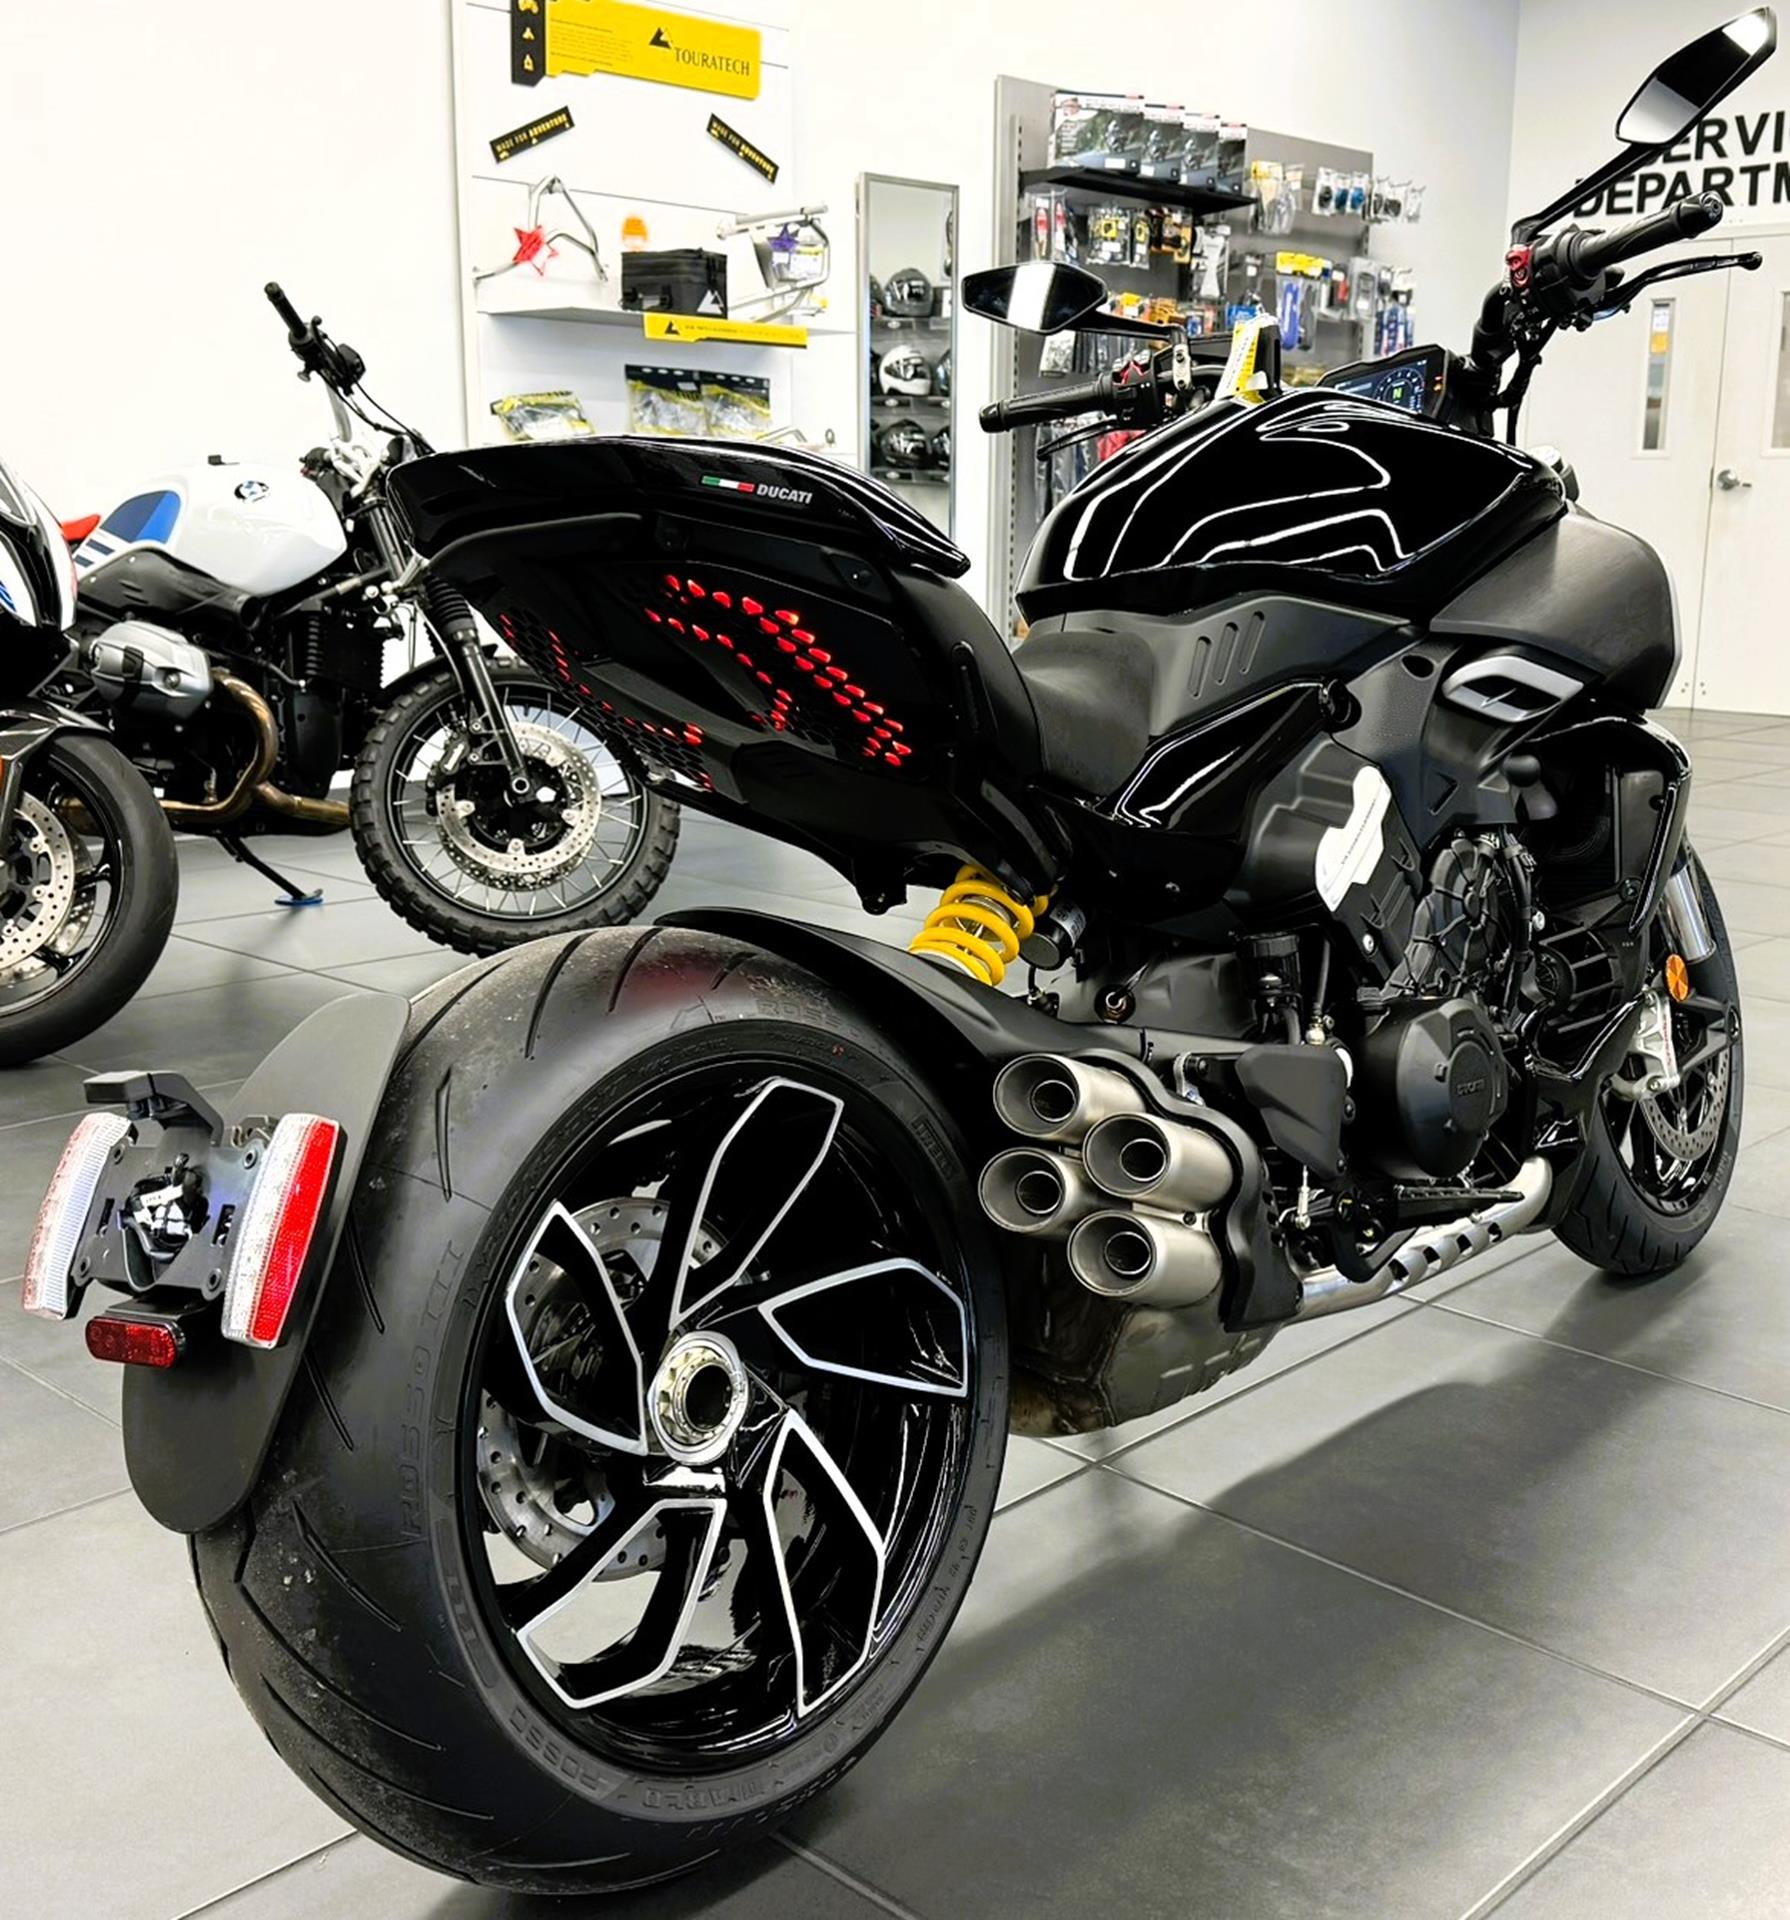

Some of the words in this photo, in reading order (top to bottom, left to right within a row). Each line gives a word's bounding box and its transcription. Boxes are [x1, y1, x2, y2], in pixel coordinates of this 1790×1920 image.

[674, 46, 750, 76] TOURATECH
[756, 483, 813, 505] DUCATI
[508, 1704, 607, 1791] ROSSO
